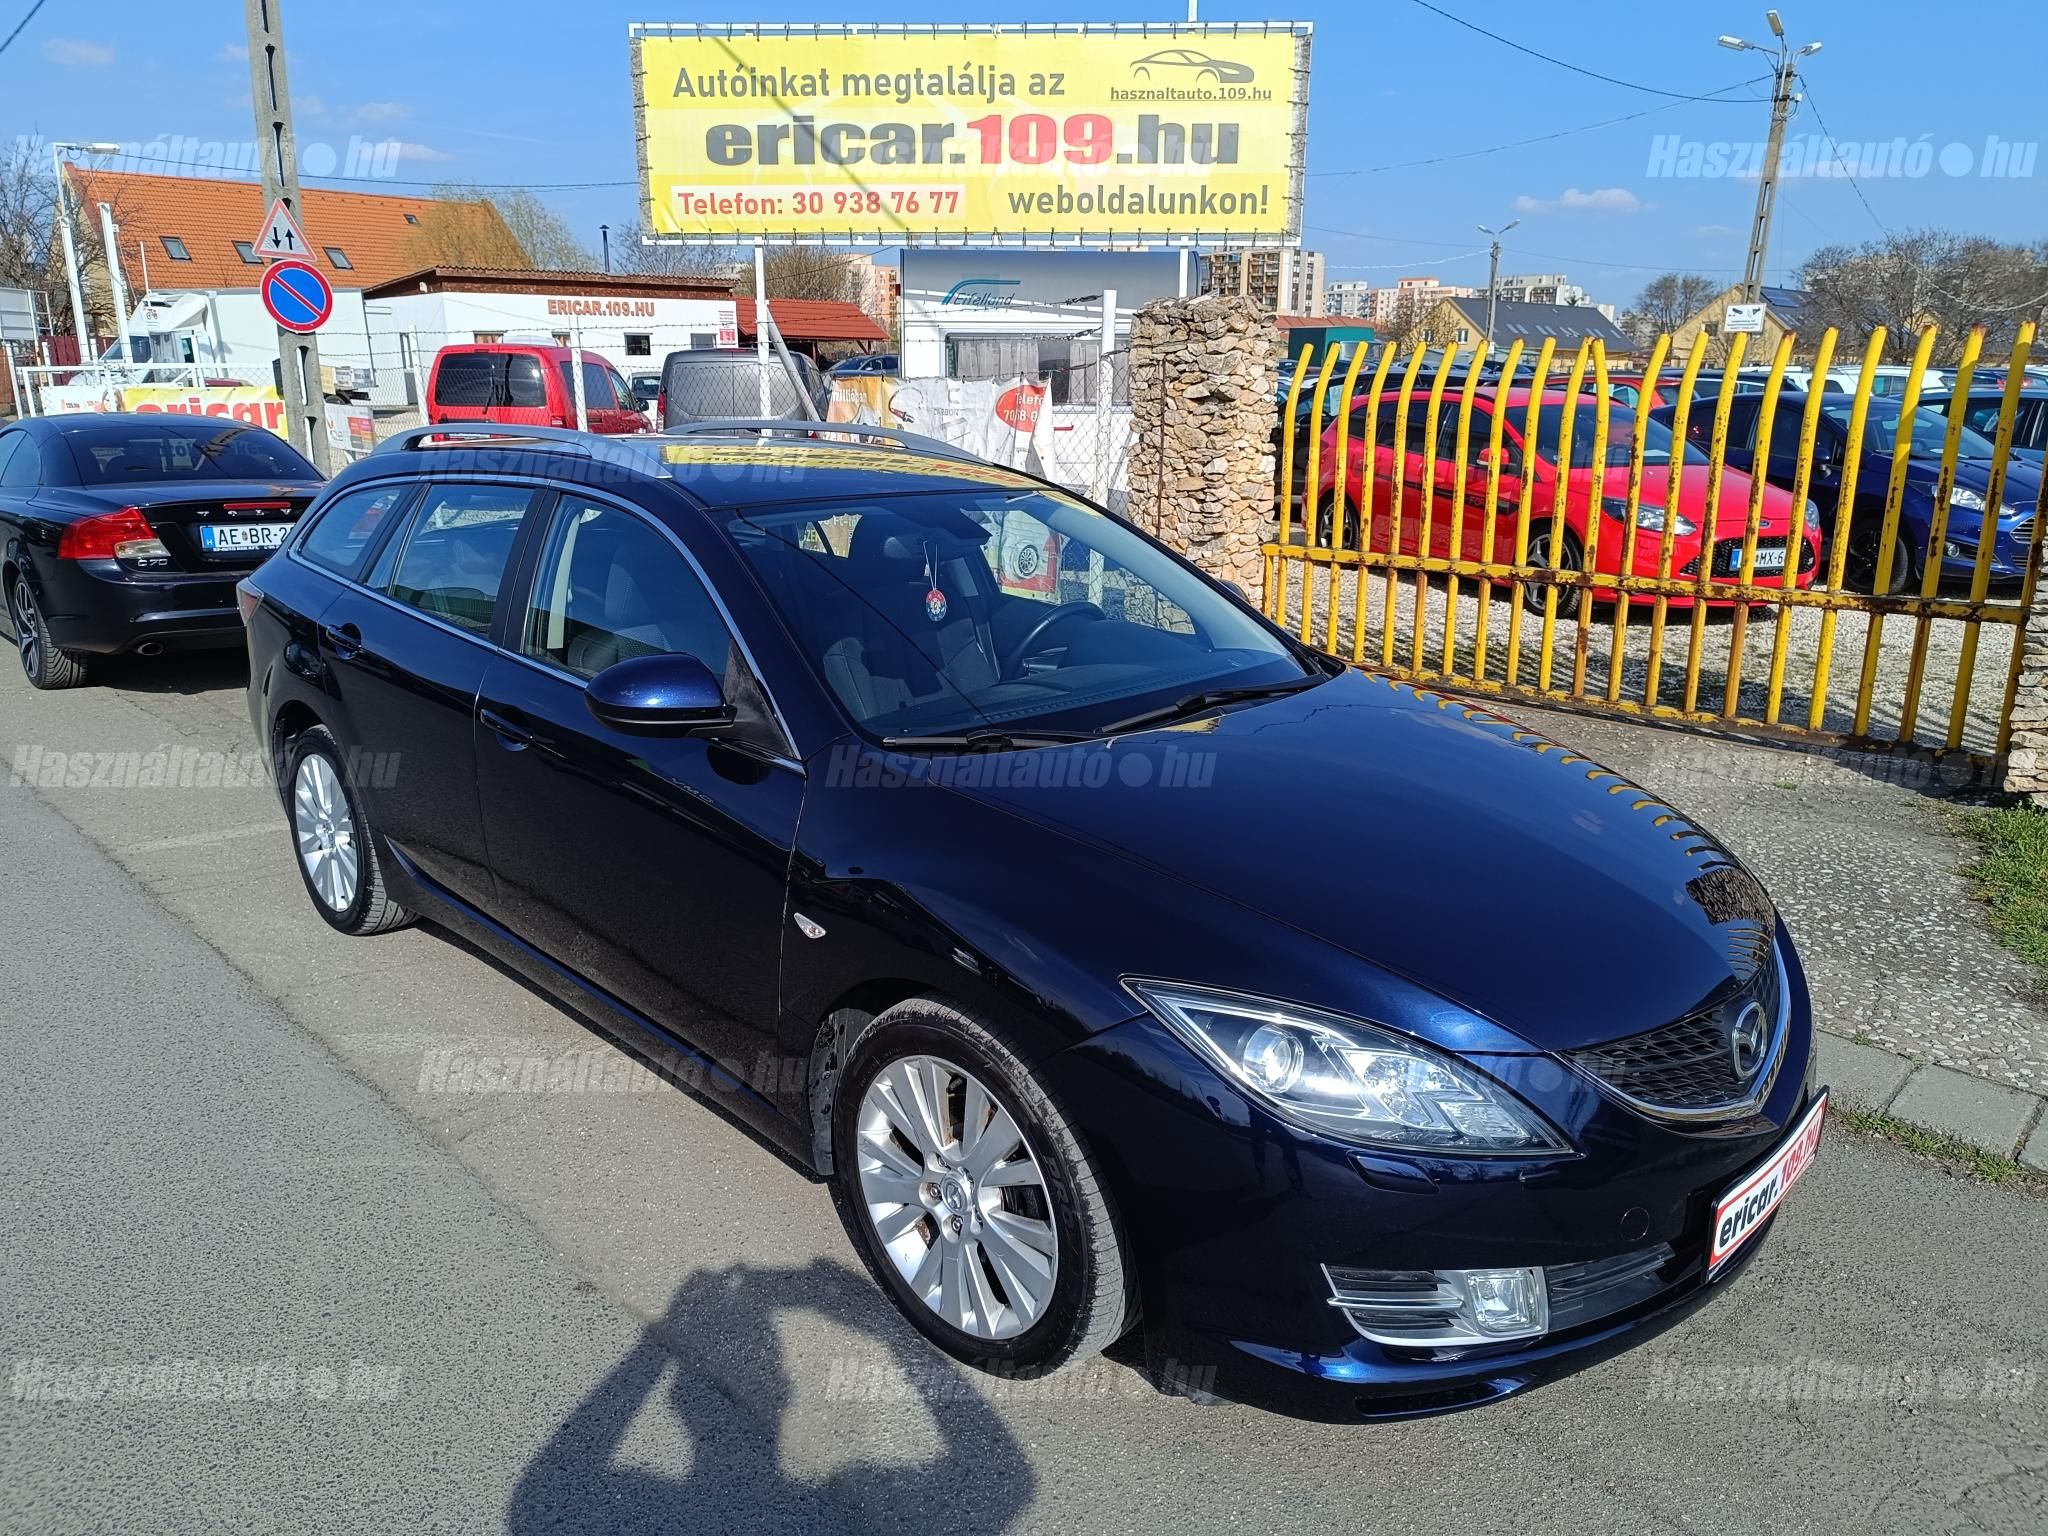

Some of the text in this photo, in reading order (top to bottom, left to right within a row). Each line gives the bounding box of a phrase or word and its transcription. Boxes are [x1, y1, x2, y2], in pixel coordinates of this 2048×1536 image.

[672, 61, 1065, 104] Autóinkat megtalálja az
[1110, 87, 1272, 101] hasznaltauto.109.hu
[705, 112, 1239, 167] ericar.109.hu
[677, 191, 959, 215] Telefon: 30 938 76 77
[1008, 184, 1268, 215] weboldalunkon!
[547, 299, 655, 317] ERICAR.109.HU
[953, 292, 1015, 306] Eifelland
[218, 528, 241, 546] AE
[249, 526, 293, 544] BR-2
[1758, 551, 1785, 565] MX-6
